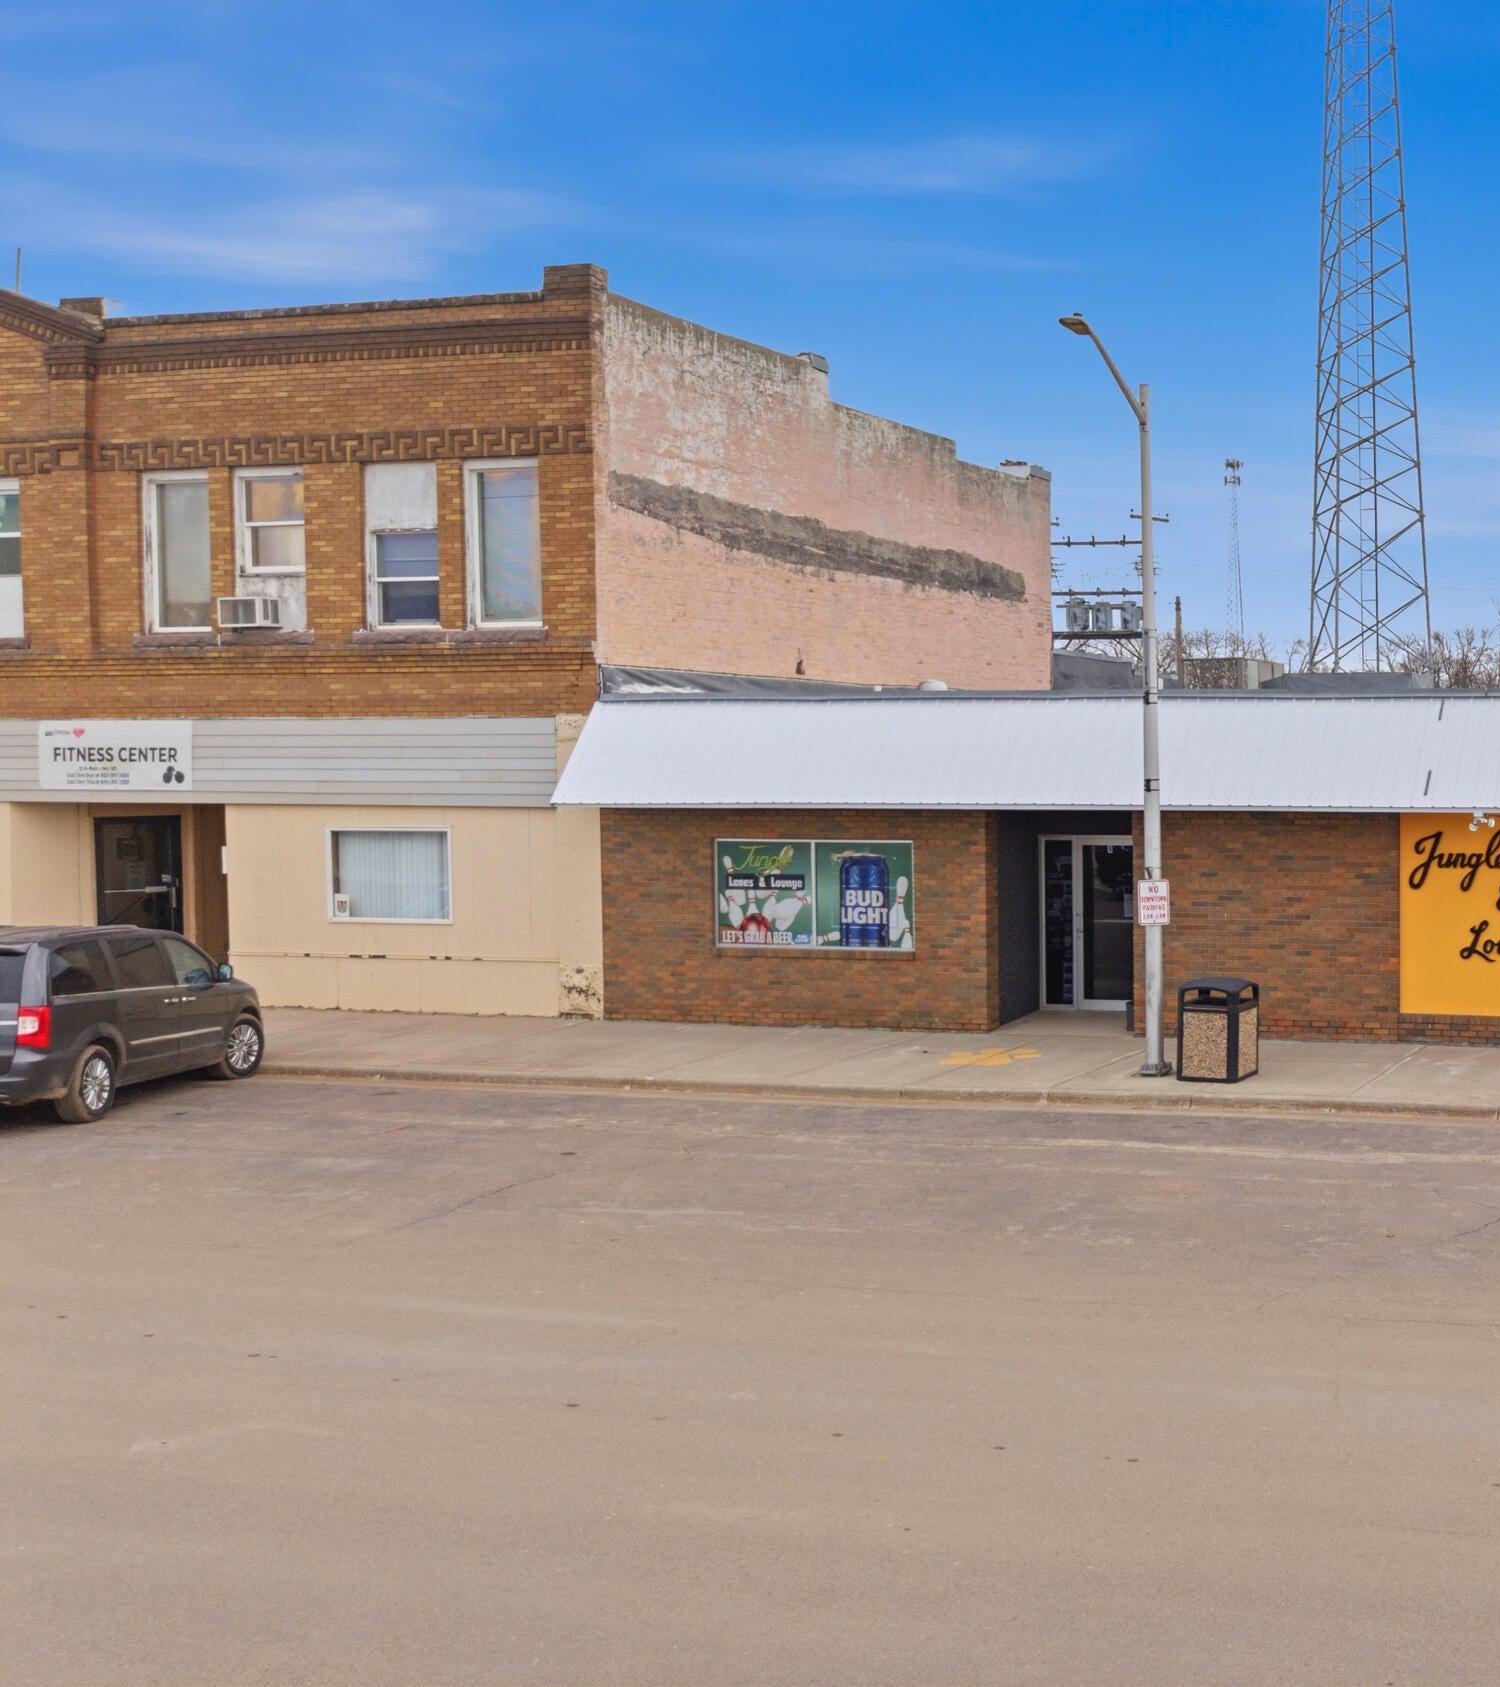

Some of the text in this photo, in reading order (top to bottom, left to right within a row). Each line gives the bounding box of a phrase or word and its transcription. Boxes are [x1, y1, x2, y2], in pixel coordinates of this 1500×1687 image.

[53, 747, 178, 762] FITNESS CENTER
[728, 876, 803, 890] Lanes & Lounge
[1148, 885, 1159, 893] NO
[845, 890, 884, 907] BUD
[841, 907, 888, 924] LIGHT
[722, 930, 743, 942] LET'S
[773, 931, 793, 944] BEER
